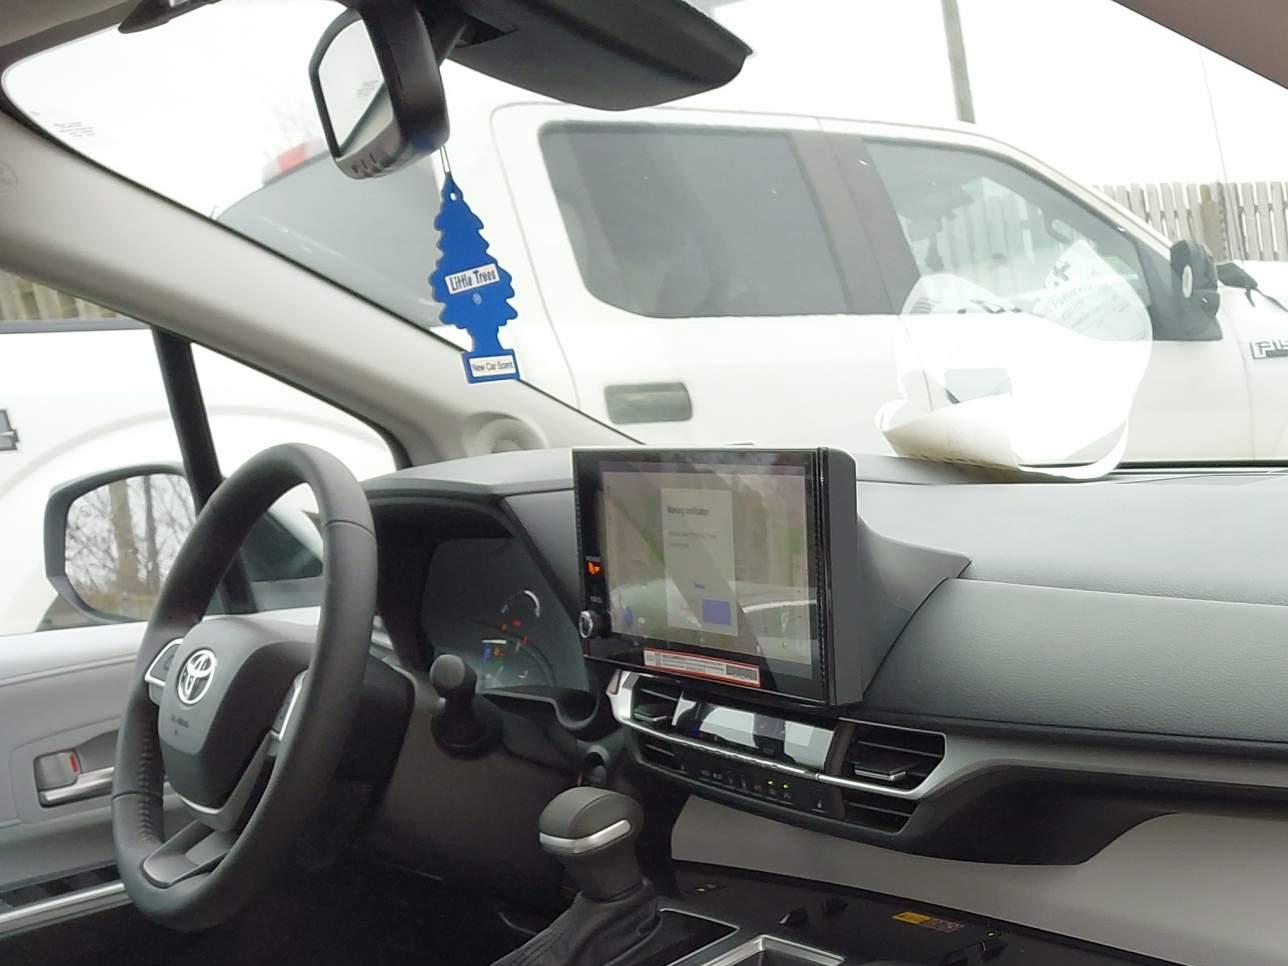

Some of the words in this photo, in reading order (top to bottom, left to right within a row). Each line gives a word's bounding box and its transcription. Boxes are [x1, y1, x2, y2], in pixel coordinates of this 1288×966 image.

[449, 273, 473, 292] Little
[473, 269, 497, 285] Trees
[471, 363, 485, 371] New
